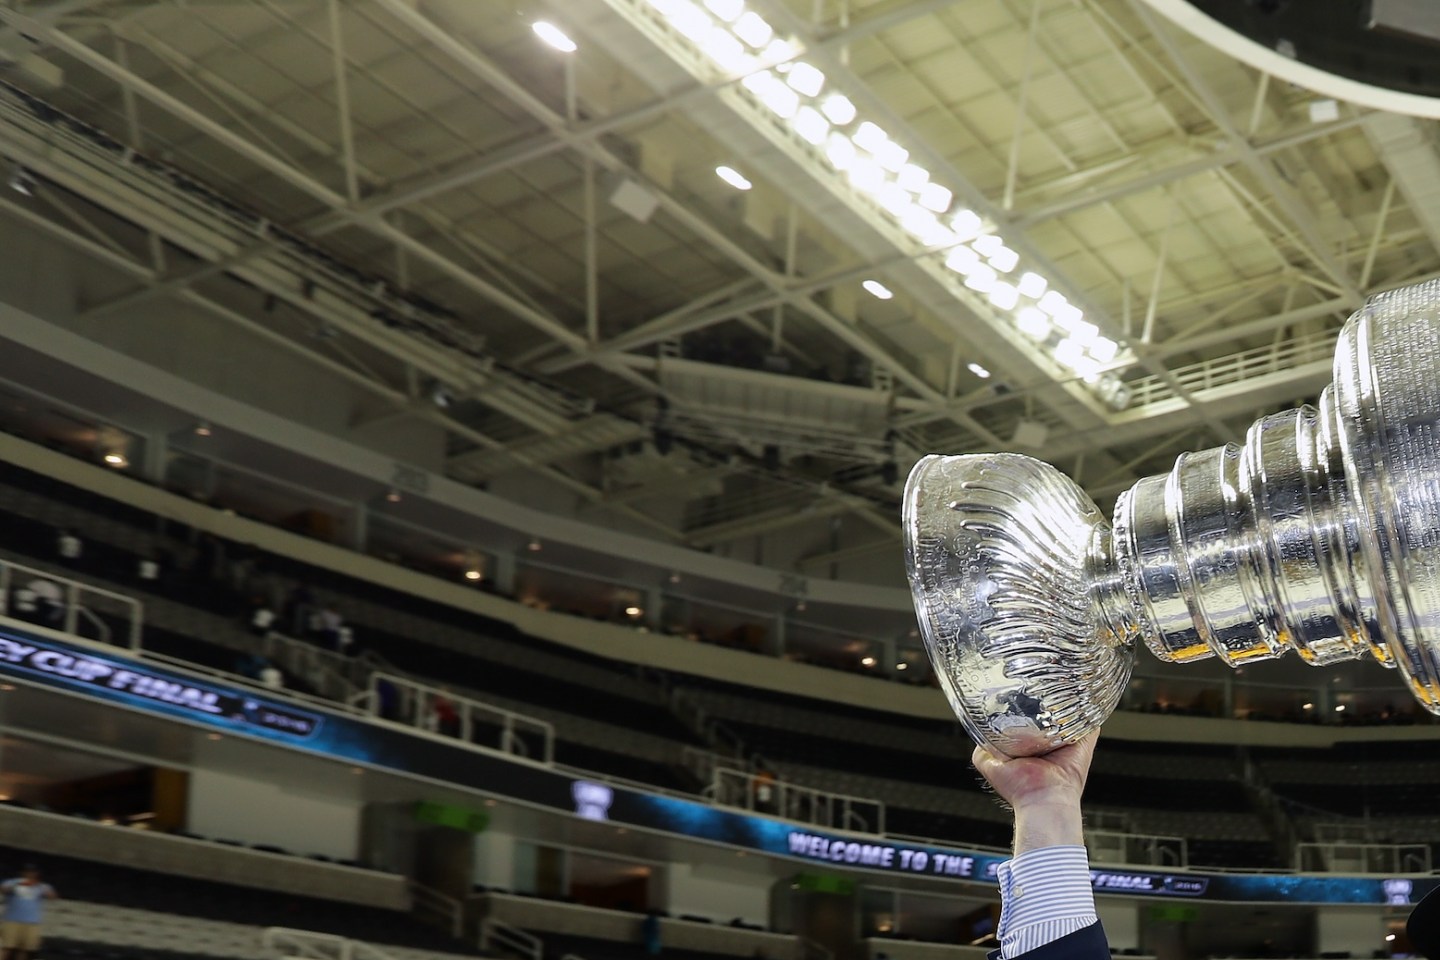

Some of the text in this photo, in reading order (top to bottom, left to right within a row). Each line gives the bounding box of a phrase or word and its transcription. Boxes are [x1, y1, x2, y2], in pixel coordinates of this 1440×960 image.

[31, 651, 113, 681] CUP
[789, 832, 895, 868] WELCOME
[899, 849, 928, 872] TO
[932, 854, 974, 877] THE
